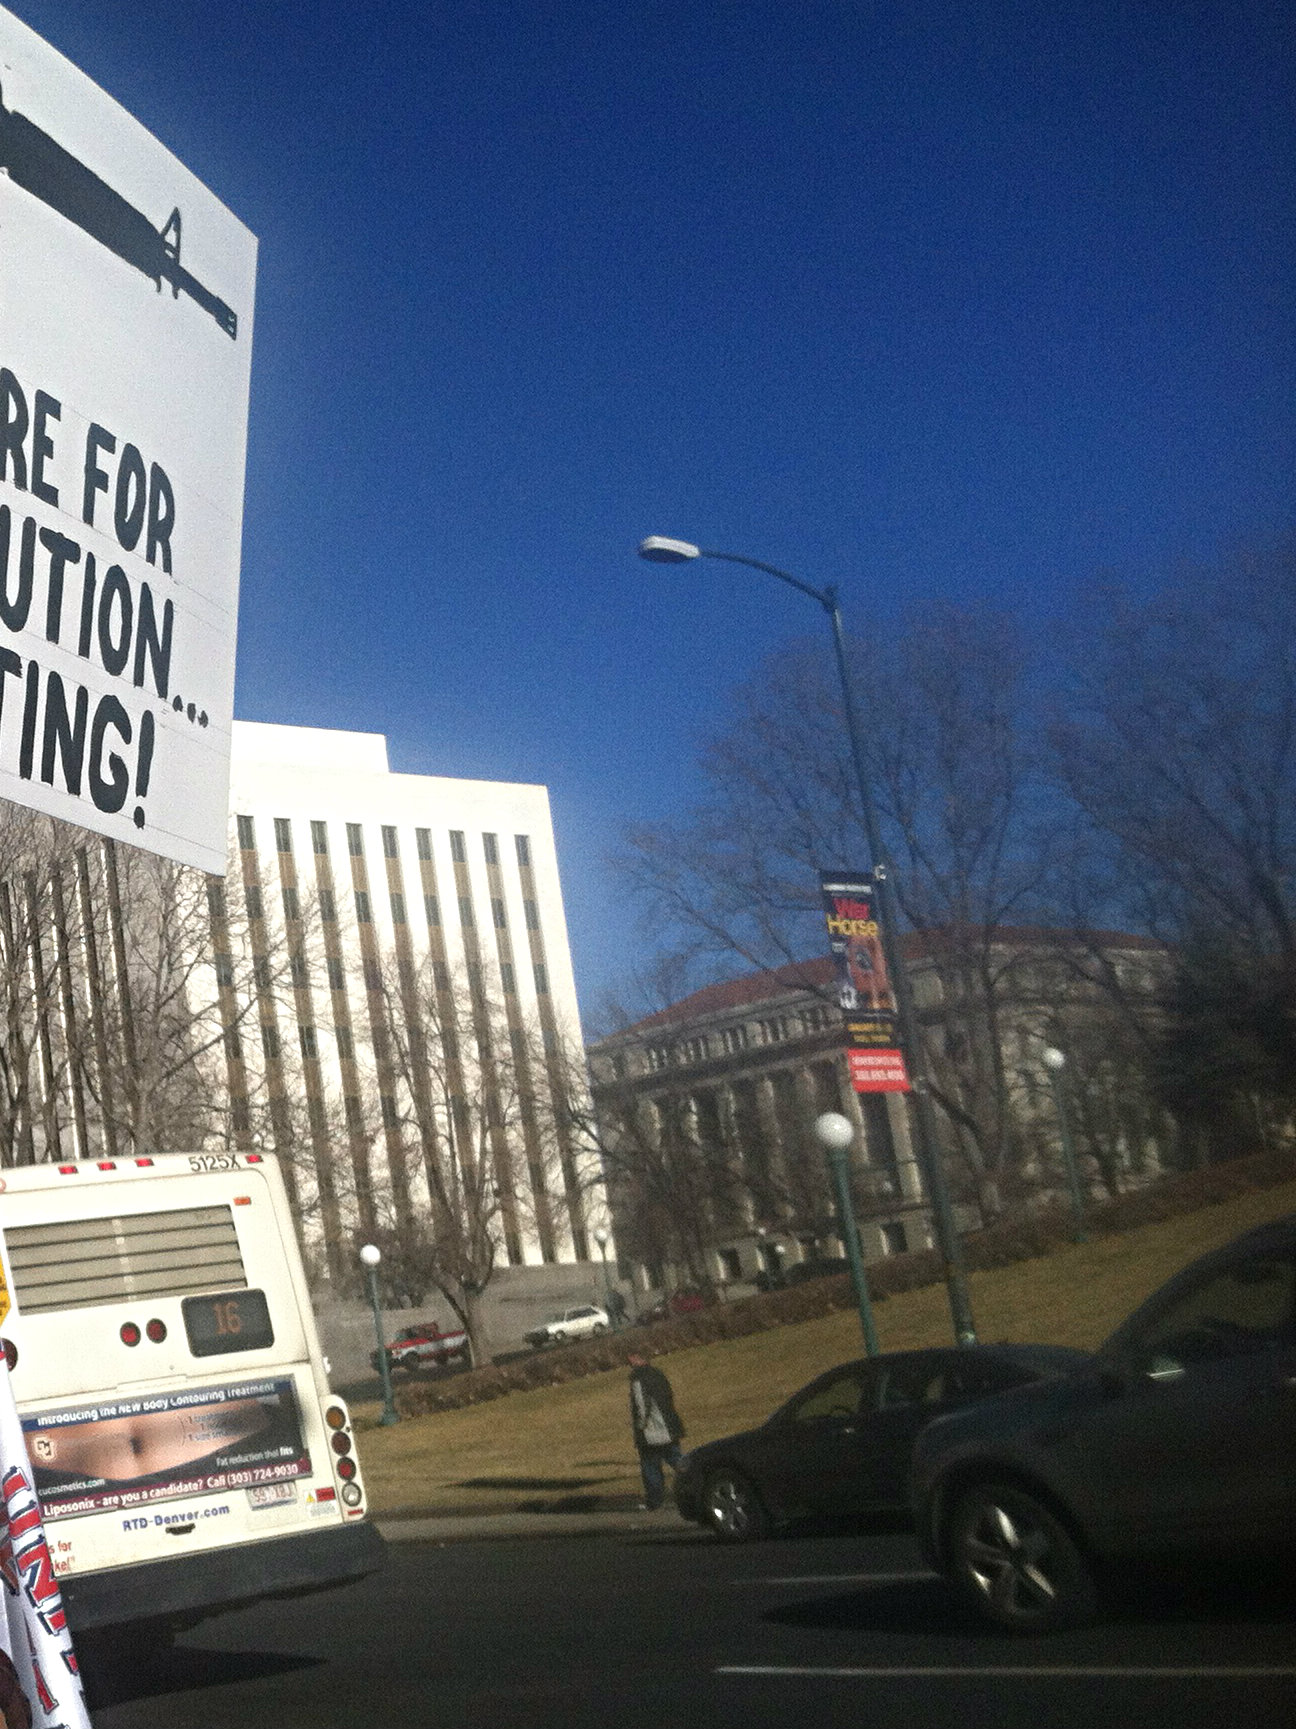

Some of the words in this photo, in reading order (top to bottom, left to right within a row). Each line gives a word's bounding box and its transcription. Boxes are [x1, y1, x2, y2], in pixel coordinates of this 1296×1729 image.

[83, 423, 176, 575] FOR
[189, 1154, 240, 1172] 5125X
[213, 1301, 241, 1335] 16
[44, 1497, 95, 1517] Liposonix
[102, 1495, 119, 1506] are
[121, 1491, 141, 1505] you
[141, 1490, 148, 1499] a
[149, 1479, 203, 1498] candidate?
[207, 1475, 225, 1488] Call
[227, 1471, 253, 1486] (303)
[254, 1463, 299, 1481] 724-9030
[122, 1505, 230, 1532] RTD-Denver.com
[57, 1540, 72, 1552] for
